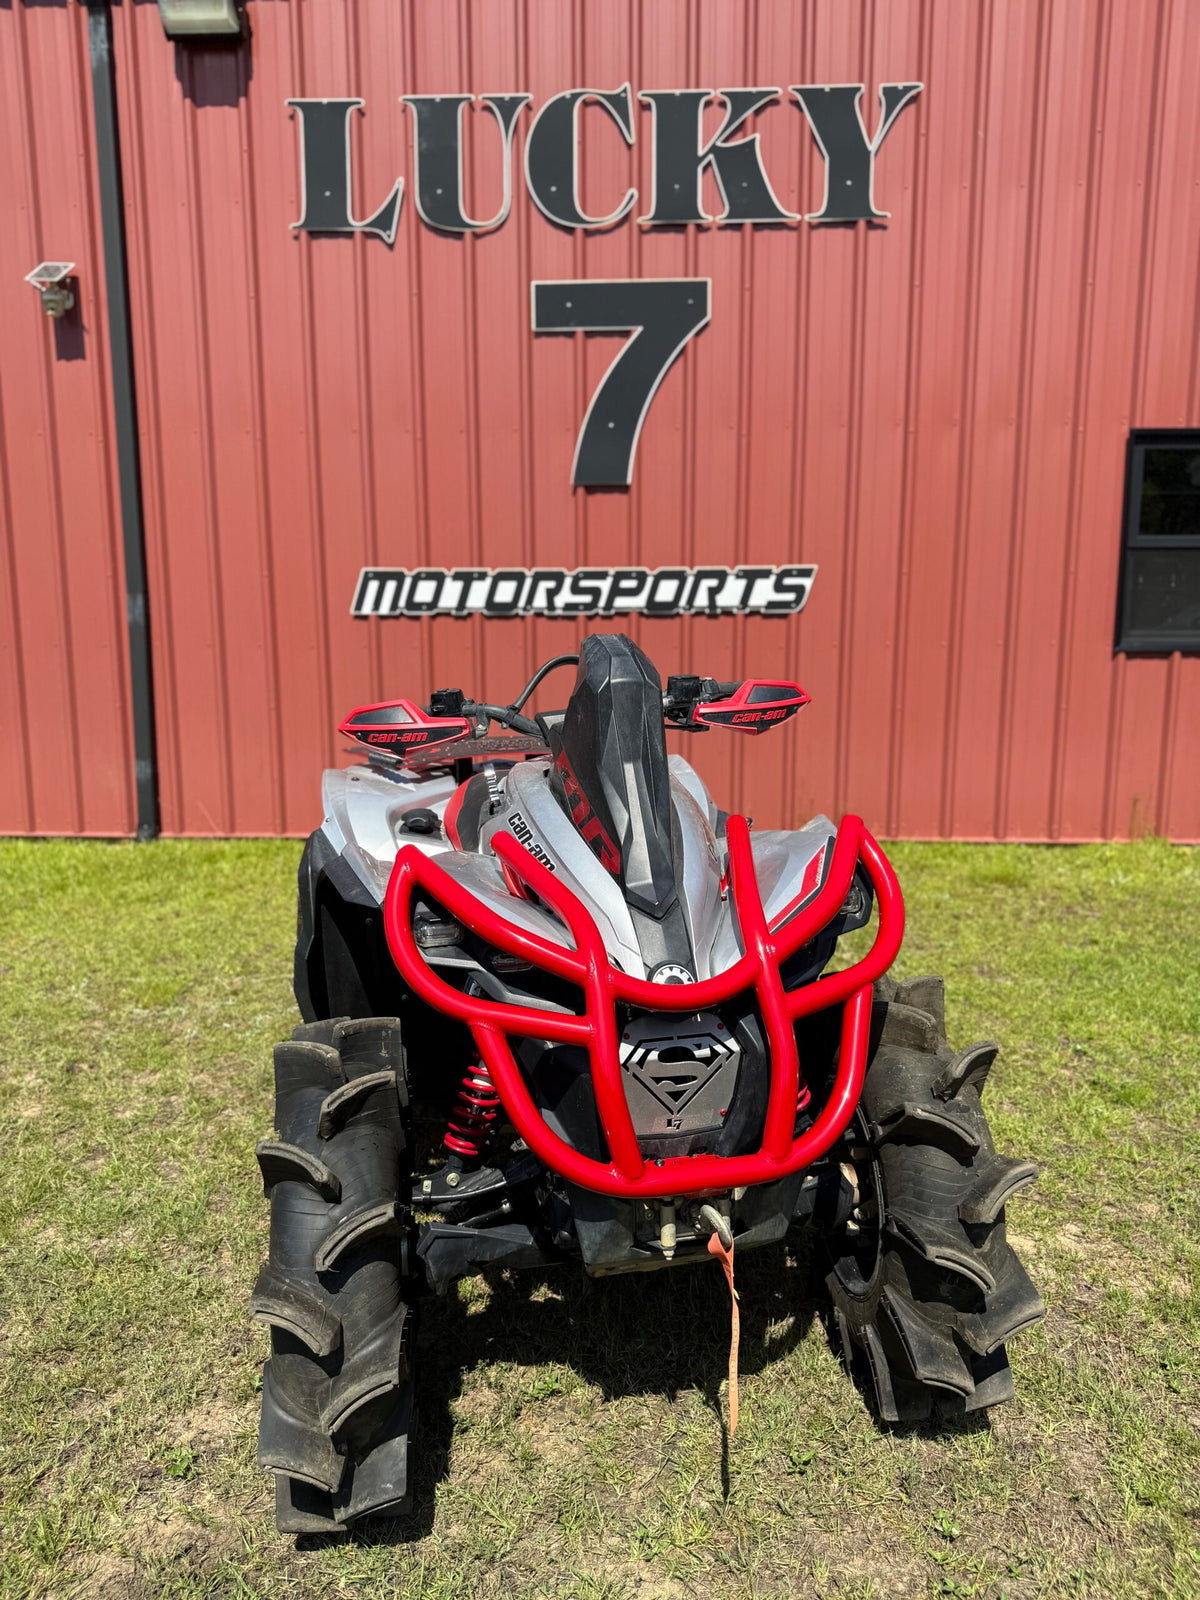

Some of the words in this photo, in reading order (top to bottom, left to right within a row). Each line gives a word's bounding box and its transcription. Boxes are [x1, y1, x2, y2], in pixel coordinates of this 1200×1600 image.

[285, 82, 924, 244] LUCKY
[531, 278, 712, 485] 7
[350, 565, 818, 616] MOTORSPORTS
[368, 732, 428, 743] can-am
[732, 709, 786, 723] can-am
